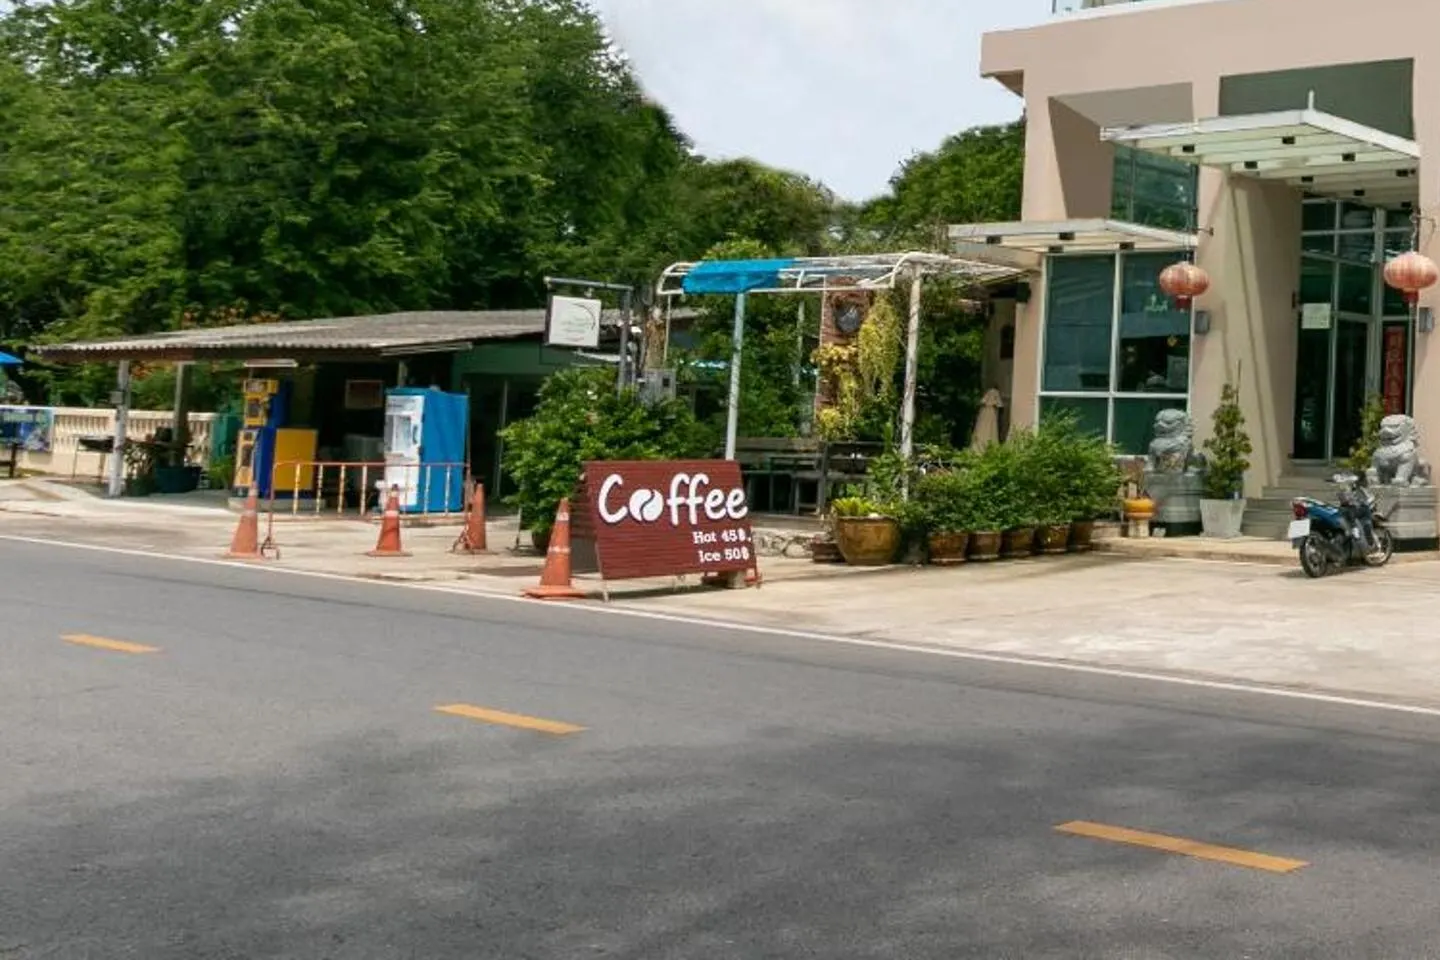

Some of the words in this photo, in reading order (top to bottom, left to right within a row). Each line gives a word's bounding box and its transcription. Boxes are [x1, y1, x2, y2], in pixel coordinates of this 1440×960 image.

[598, 473, 749, 526] Coffee
[692, 531, 717, 544] Hot
[698, 549, 721, 563] Ice
